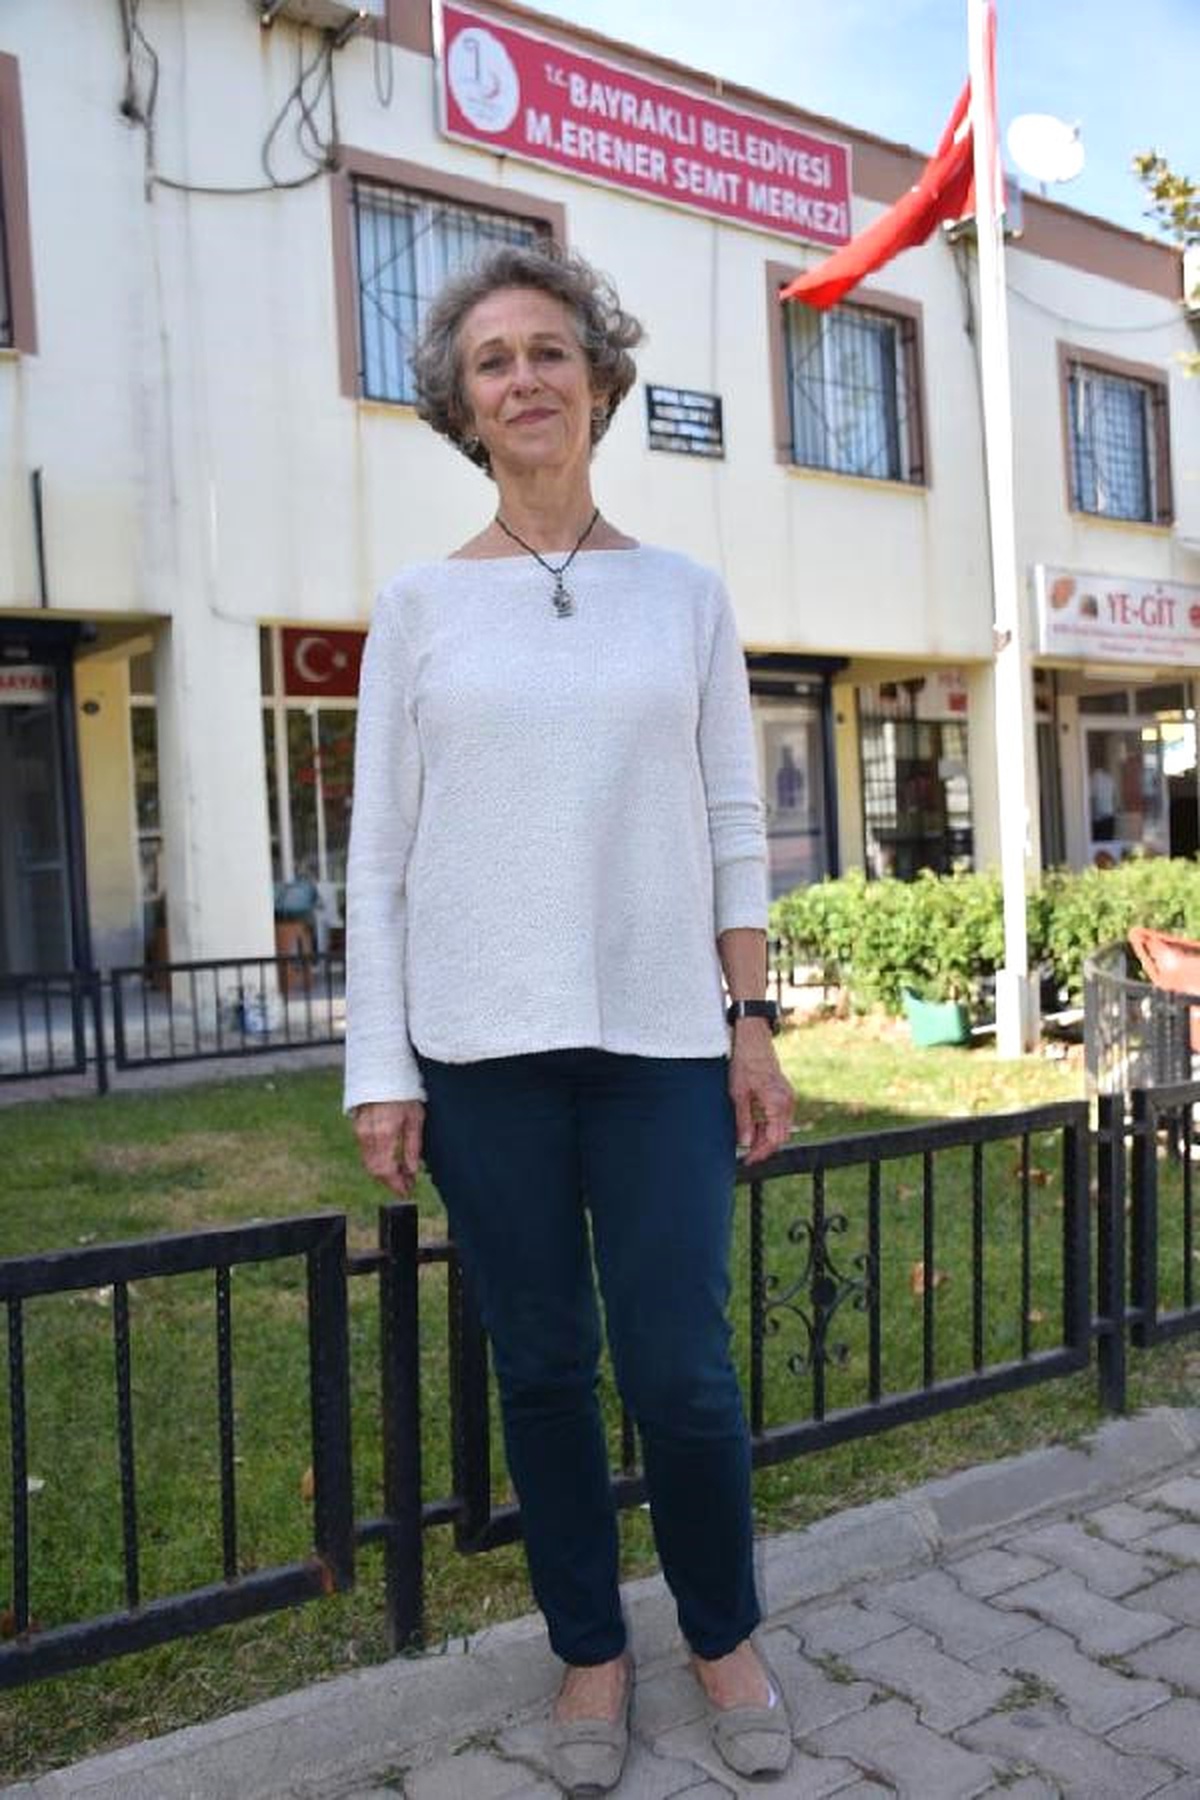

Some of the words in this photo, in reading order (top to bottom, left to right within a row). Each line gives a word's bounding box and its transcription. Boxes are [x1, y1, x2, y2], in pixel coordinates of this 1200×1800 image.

[525, 108, 668, 185] M.ERENER
[672, 157, 741, 205] SEMT
[747, 178, 849, 237] MERKEZİ
[569, 72, 697, 146] BAYRAKLI
[702, 119, 832, 189] BELEDİYESİ
